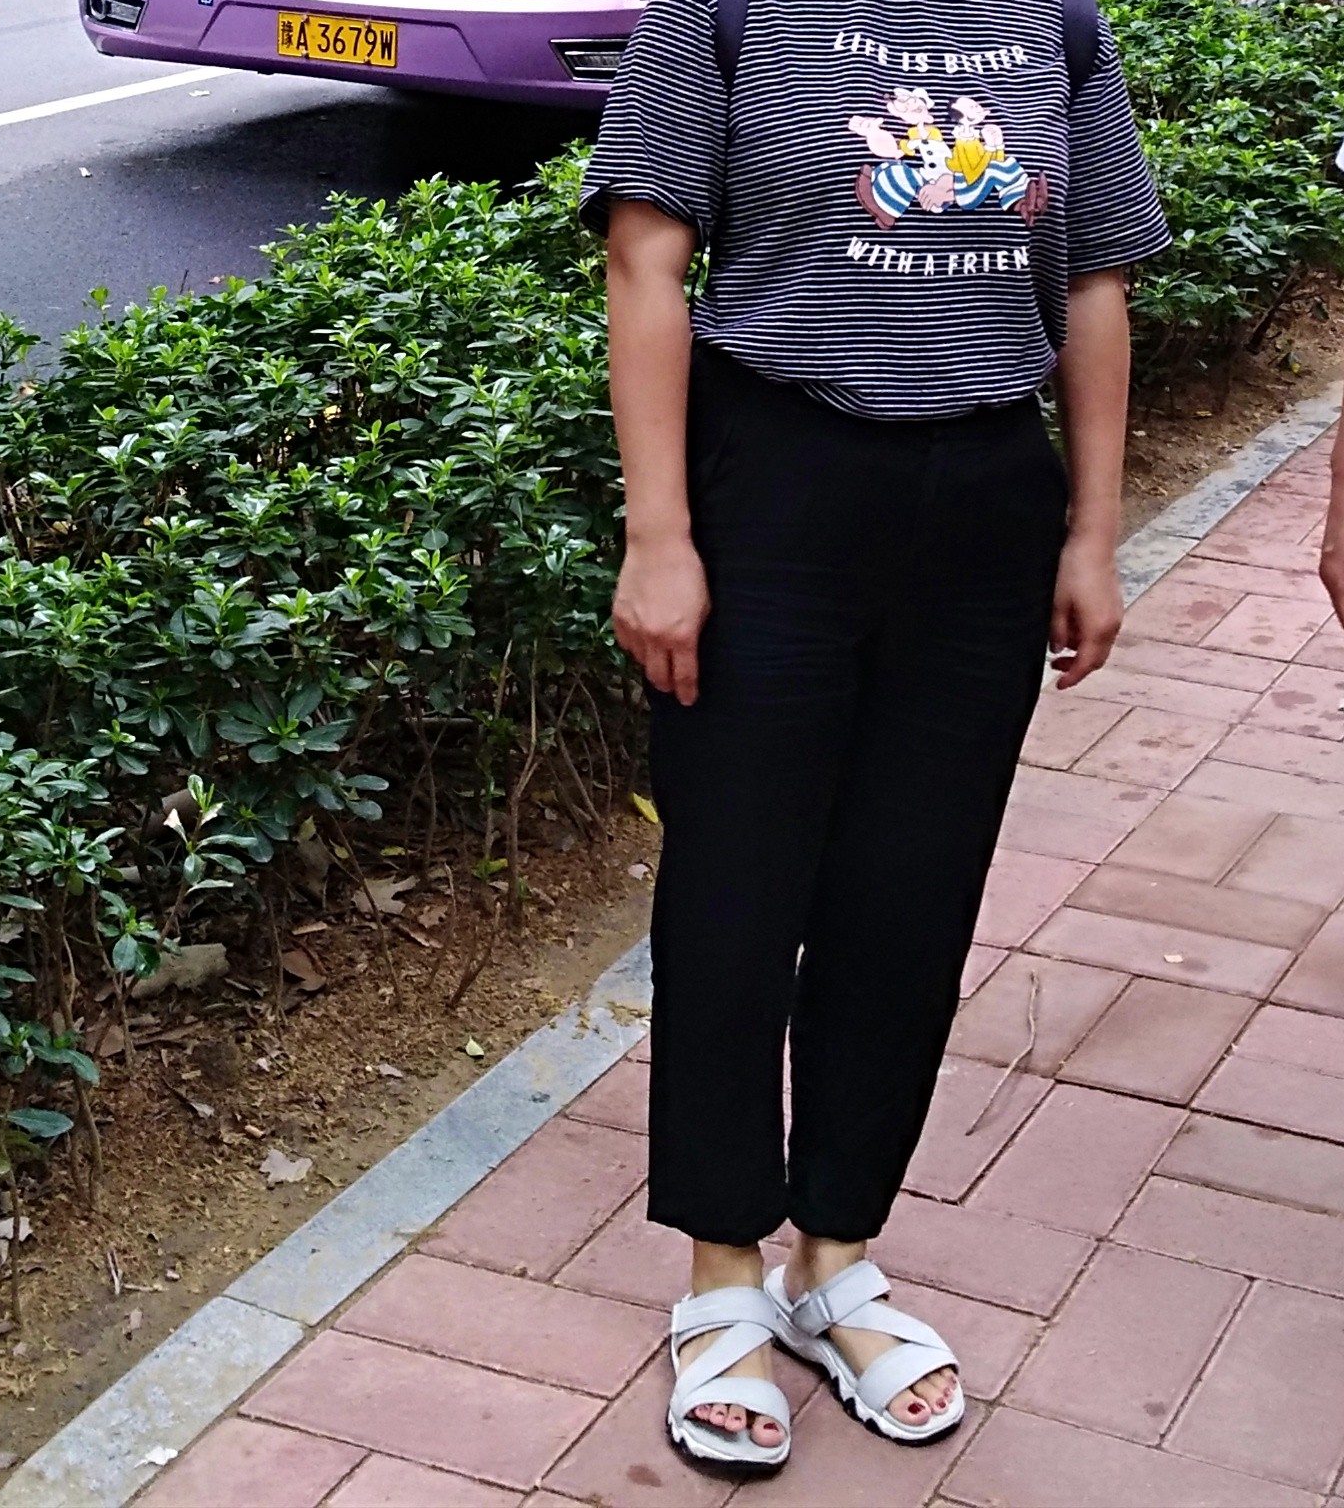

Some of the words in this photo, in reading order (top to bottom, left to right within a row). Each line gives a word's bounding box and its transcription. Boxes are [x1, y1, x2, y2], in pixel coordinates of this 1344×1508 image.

[834, 32, 889, 65] LIFE
[902, 51, 929, 73] IS
[944, 45, 1028, 74] BETTER
[846, 236, 914, 275] WITH
[923, 253, 935, 276] A
